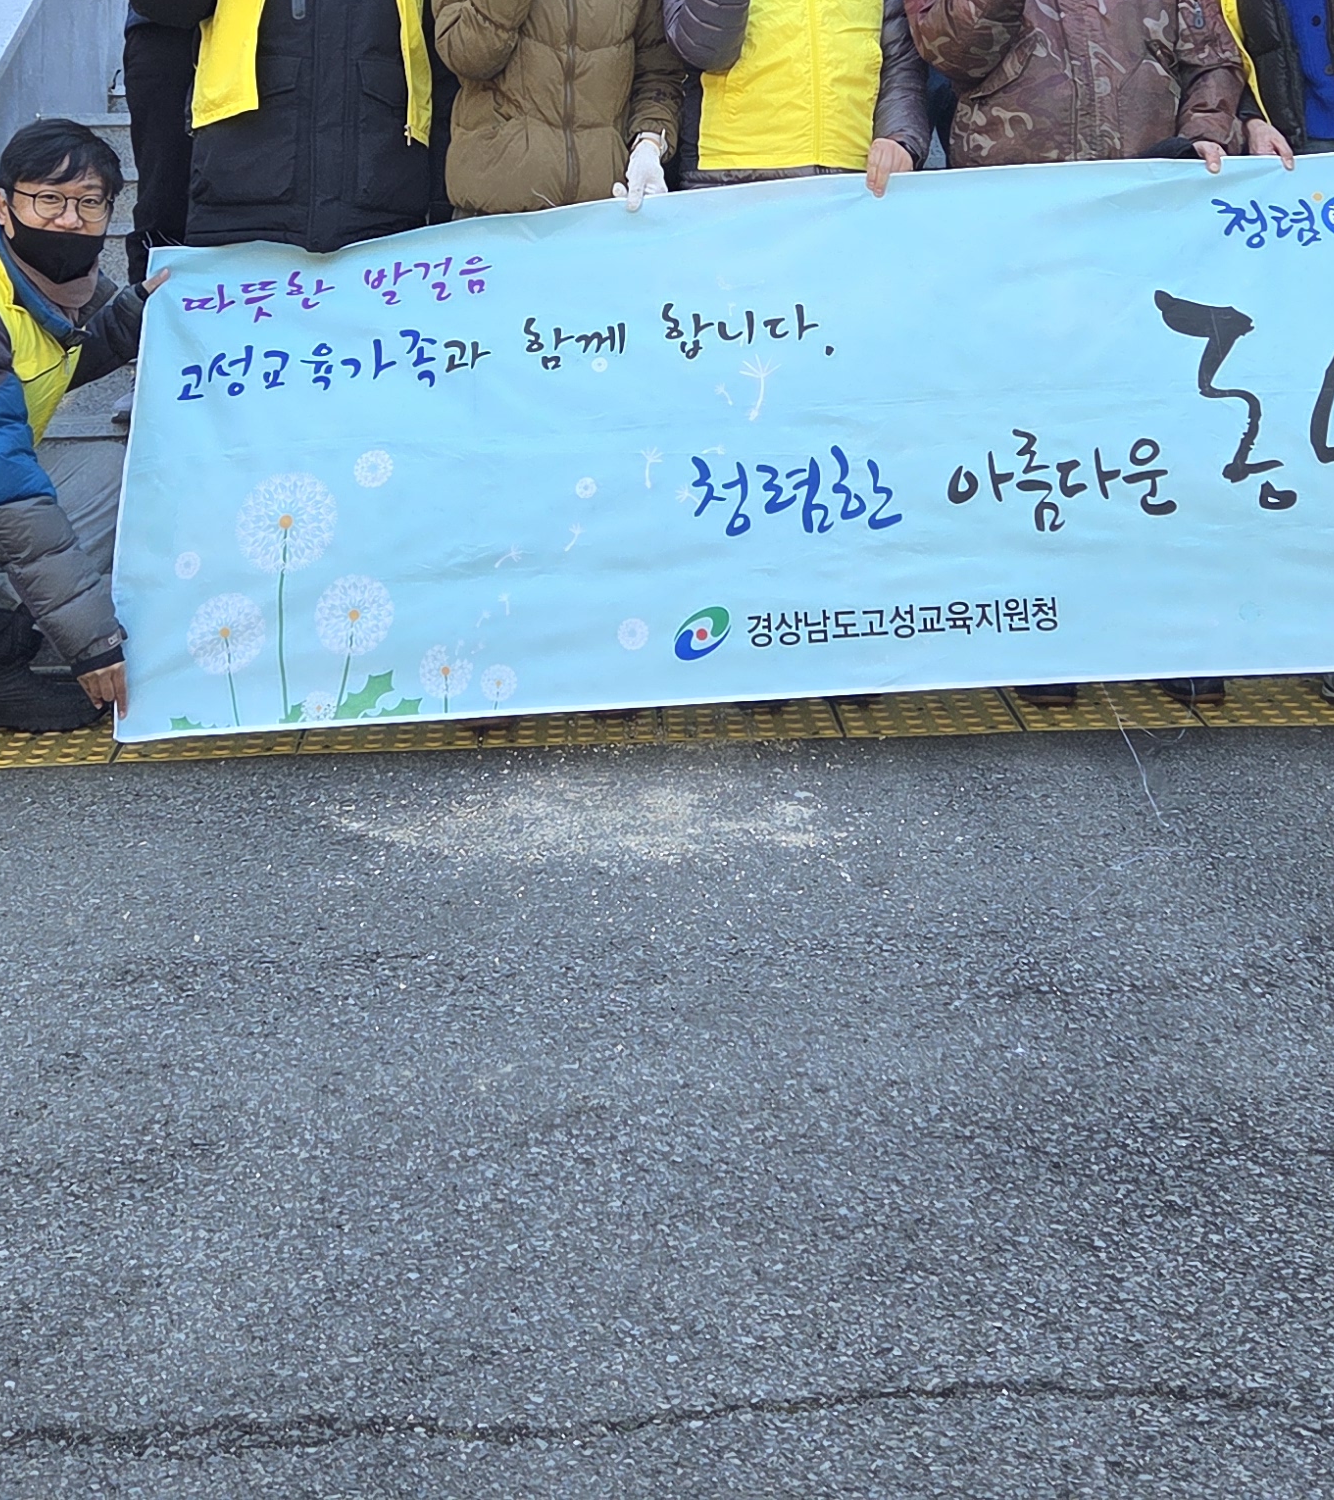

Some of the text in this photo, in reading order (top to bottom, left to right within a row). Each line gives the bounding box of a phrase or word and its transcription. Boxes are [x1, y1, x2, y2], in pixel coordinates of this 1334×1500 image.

[182, 255, 493, 322] 따뜻한 발걸음
[176, 301, 835, 401] 고성교육가족과 함께 합니다.
[691, 445, 904, 536] 청렴한
[948, 429, 1178, 533] 아름다운
[746, 596, 1059, 648] 경상남도고성교육지원청
